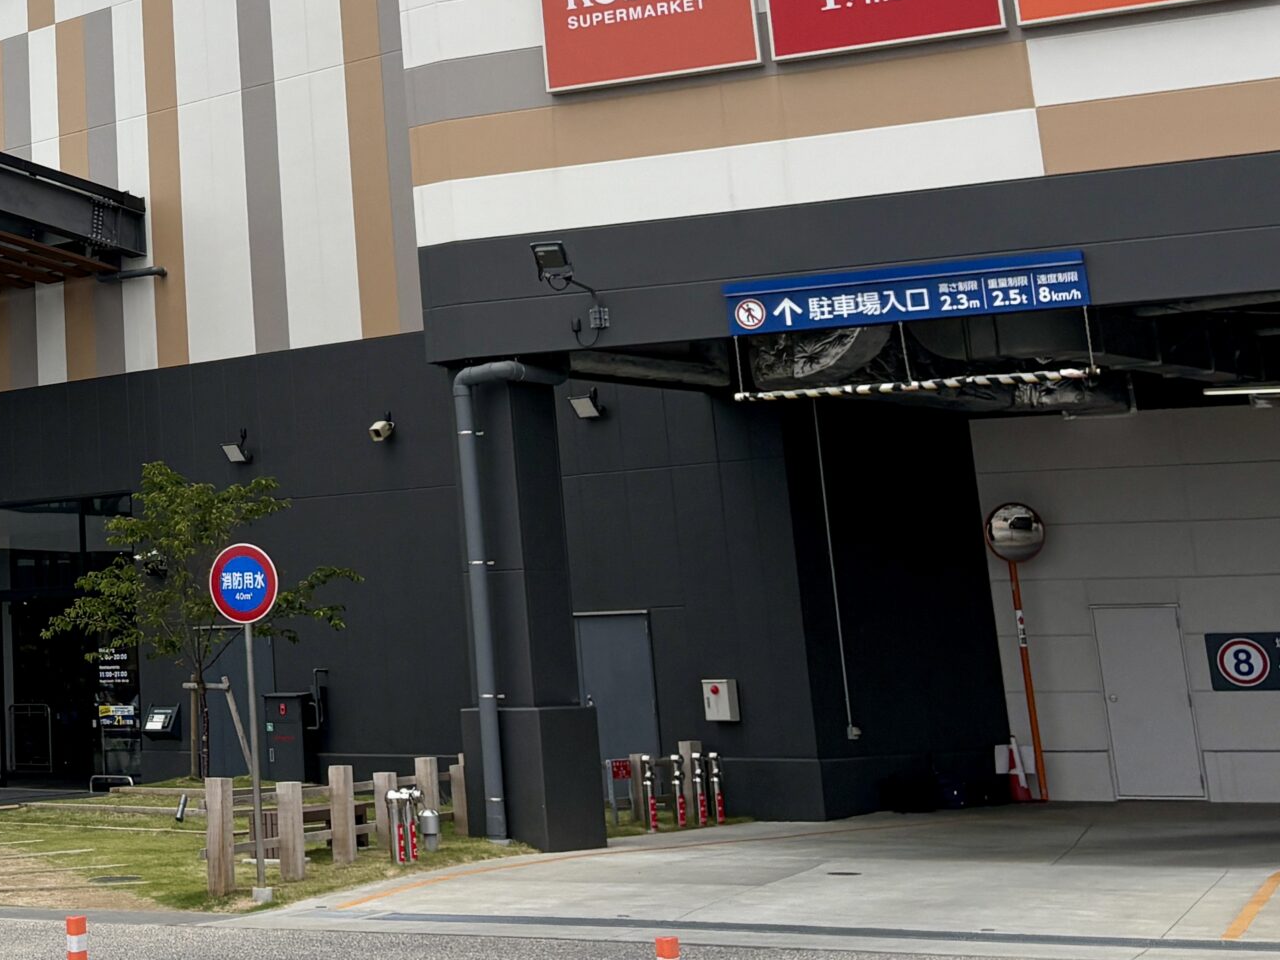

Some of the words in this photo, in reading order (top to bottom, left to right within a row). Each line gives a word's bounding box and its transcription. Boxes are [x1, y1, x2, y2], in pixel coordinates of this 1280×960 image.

[808, 288, 931, 322] 駐車場入口
[939, 293, 981, 311] 2.3m
[991, 290, 1028, 307] 2.5t
[221, 571, 265, 590] 消防用水
[1233, 648, 1255, 677] 8
